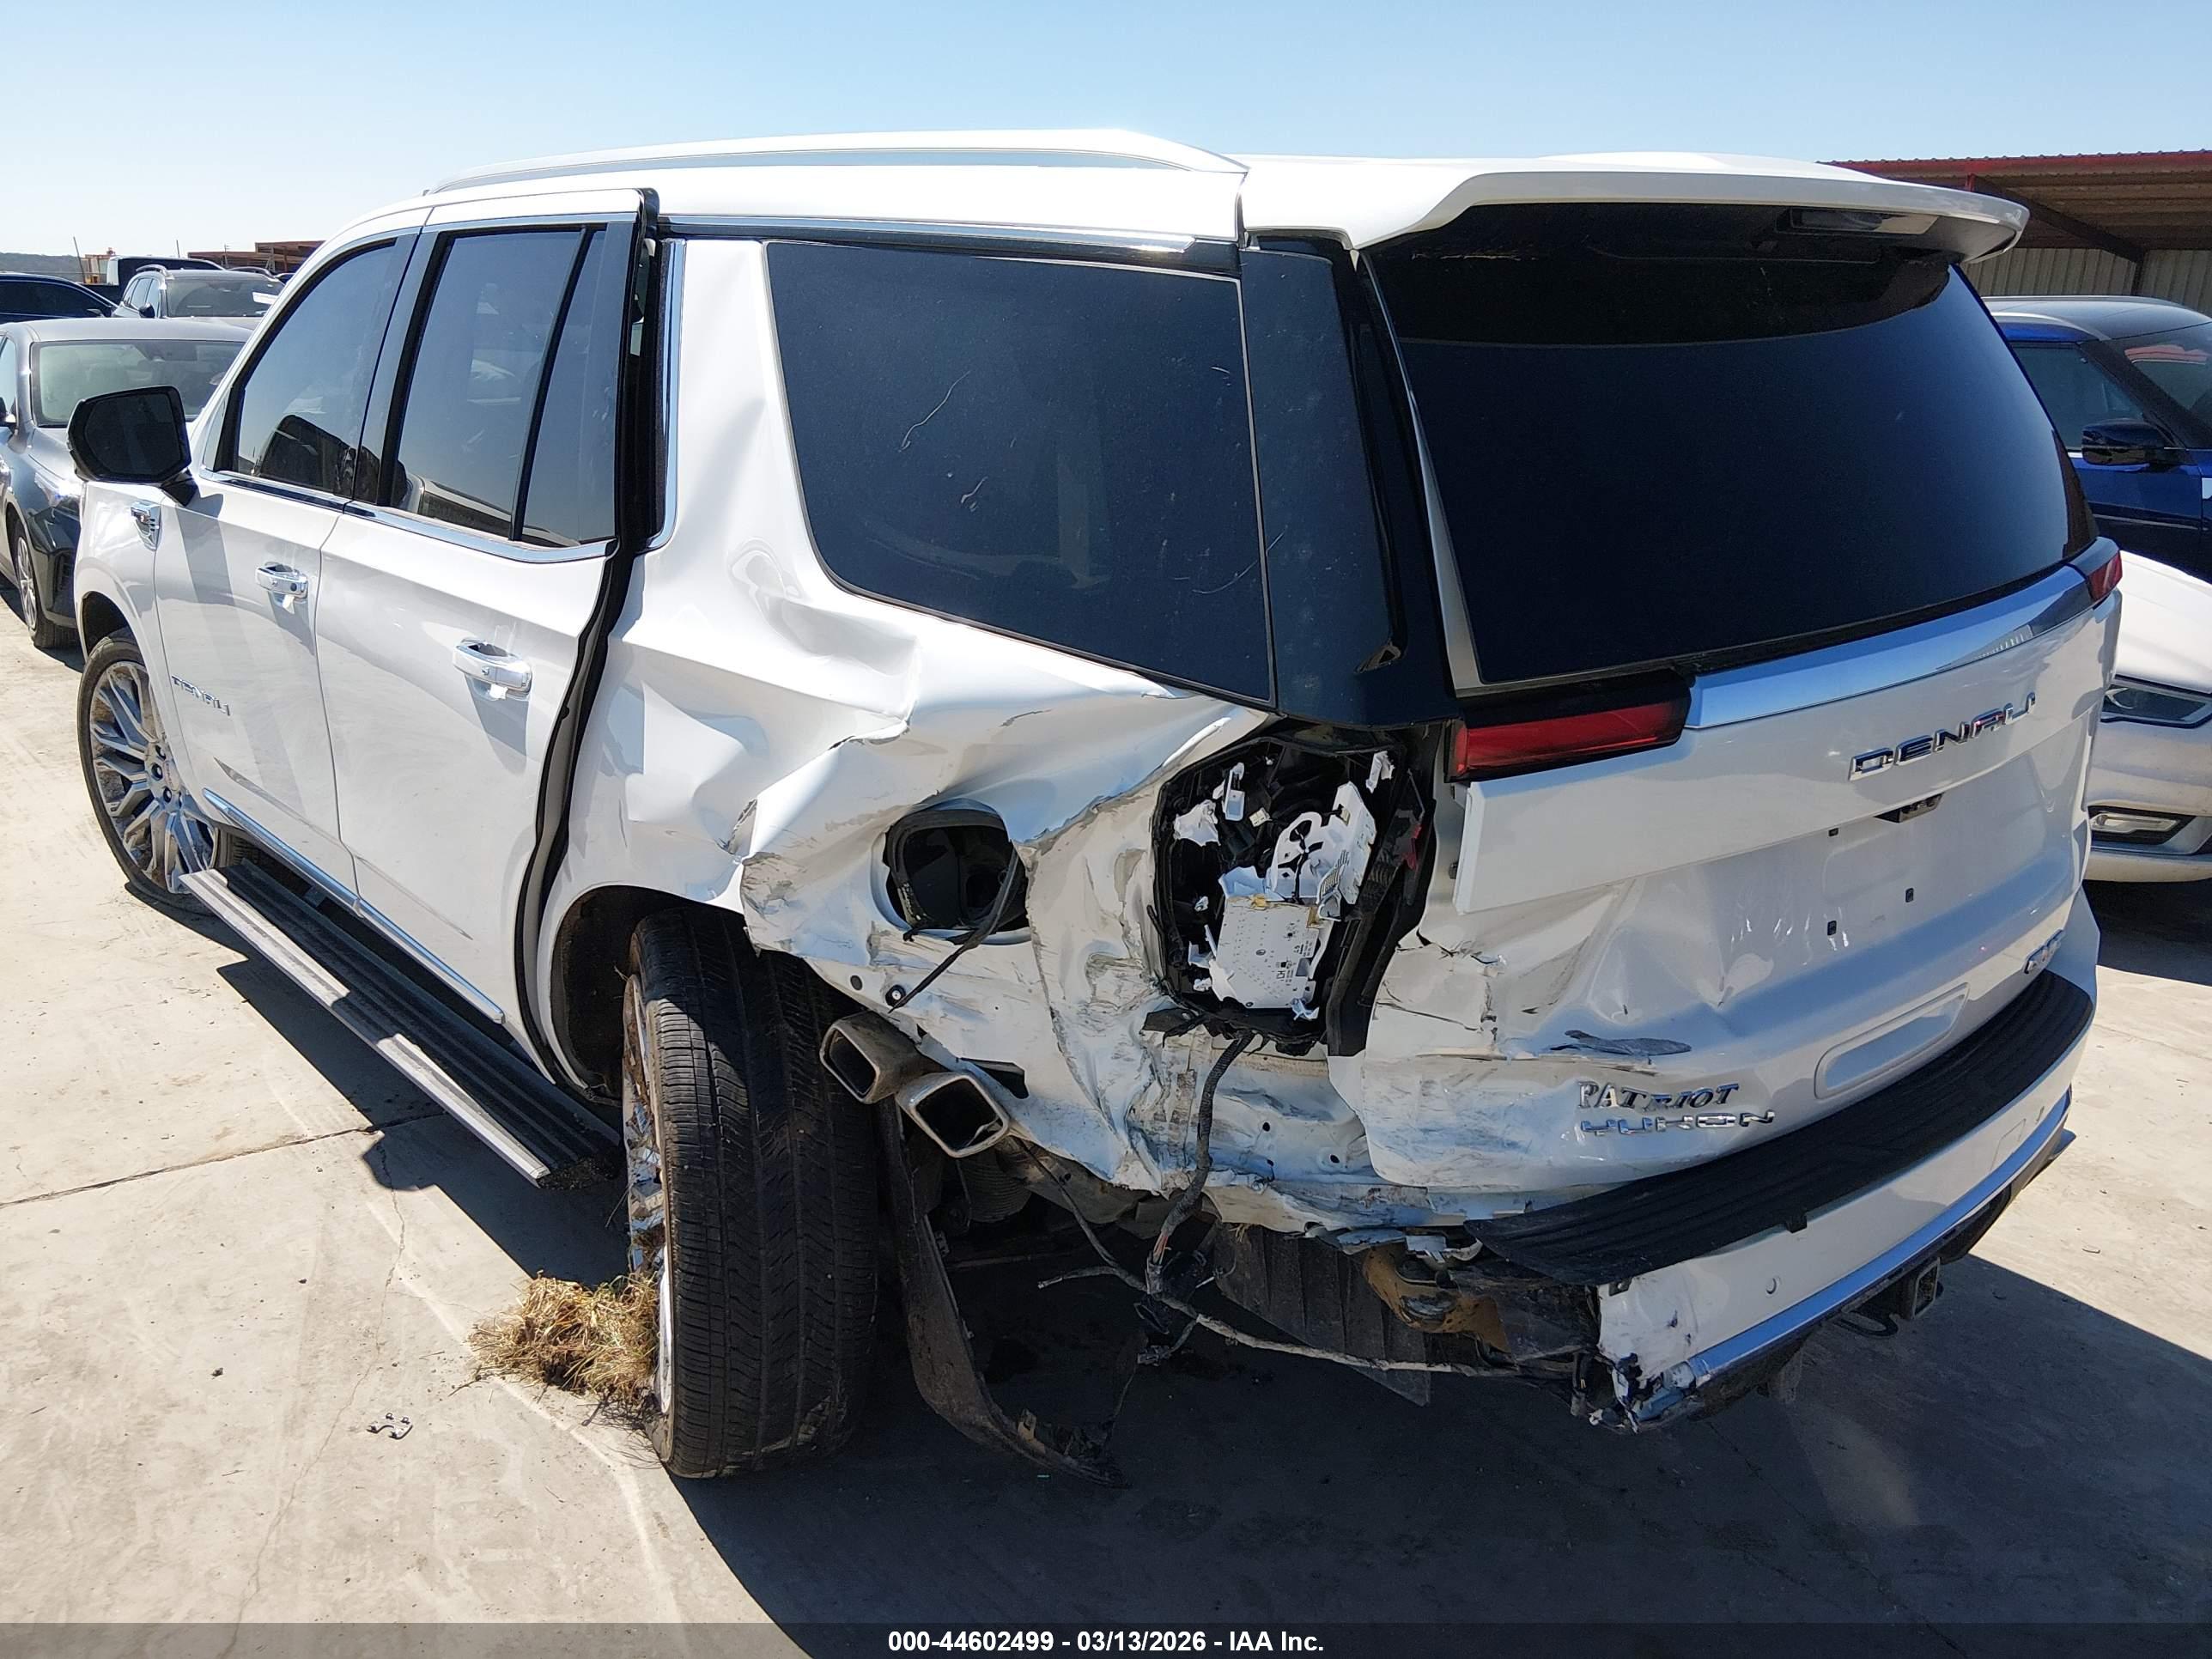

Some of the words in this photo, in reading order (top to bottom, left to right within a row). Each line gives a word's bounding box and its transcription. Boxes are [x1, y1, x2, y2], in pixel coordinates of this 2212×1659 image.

[1848, 692, 2037, 781] DENALI
[1577, 1079, 1740, 1112] PATRIOT
[1581, 1109, 1776, 1136] YUKON
